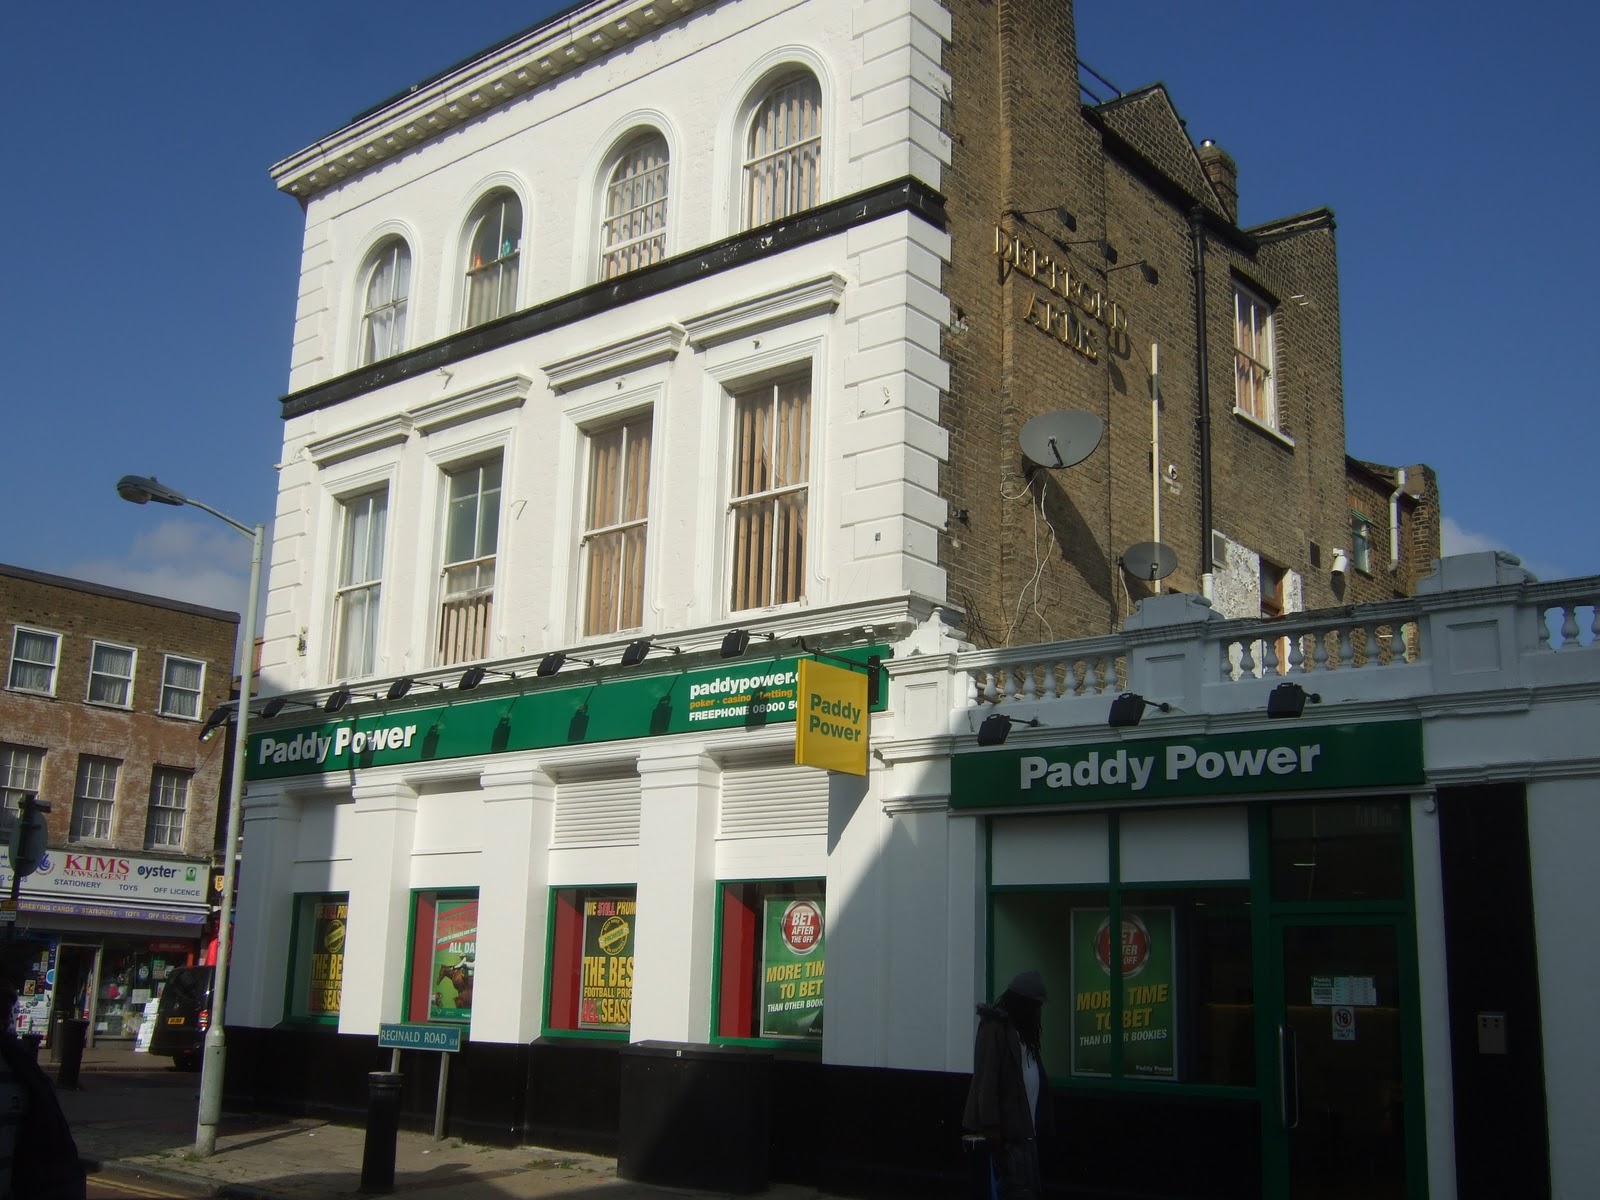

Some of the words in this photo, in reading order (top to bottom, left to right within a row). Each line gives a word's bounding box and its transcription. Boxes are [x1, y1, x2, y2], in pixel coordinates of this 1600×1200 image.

[690, 699, 715, 710] poker
[722, 694, 751, 705] casino
[759, 689, 793, 699] betting
[689, 706, 750, 721] FREEPHONE
[752, 702, 785, 713] 08000
[810, 693, 861, 724] Paddy
[809, 715, 861, 742] Power
[259, 731, 331, 765] Paddy
[334, 724, 416, 756] Power
[1020, 750, 1155, 791] Paddy
[1165, 743, 1320, 780] Power
[64, 854, 130, 874] KIMS
[63, 869, 129, 881] NEWSAGENT
[54, 878, 101, 888] STATIONERY
[119, 884, 138, 892] TOYS
[19, 902, 51, 911] GREETING
[53, 905, 74, 913] CARDS
[81, 907, 117, 916] STATIONERY
[587, 902, 596, 916] WE
[597, 901, 615, 916] STILL
[791, 912, 814, 926] BET
[791, 926, 814, 935] AFTER
[1108, 928, 1137, 945] ET
[802, 935, 814, 943] OFF
[449, 942, 462, 953] ALL
[1108, 945, 1138, 956] TER
[312, 954, 328, 979] THE
[1123, 957, 1138, 965] OFF
[584, 957, 606, 987] THE
[766, 963, 802, 983] MORE
[584, 987, 615, 998] FOOTBALL
[780, 984, 795, 999] TO
[800, 980, 823, 998] BET
[1076, 990, 1111, 1012] MOR
[1127, 984, 1169, 1006] TIME
[767, 1003, 784, 1013] THAN
[784, 1000, 804, 1011] OTHER
[1122, 1008, 1153, 1029] BET
[1337, 1012, 1349, 1024] 18
[381, 1030, 420, 1043] REGINALD
[424, 1032, 447, 1044] ROAD
[1080, 1035, 1100, 1047] THAN
[1103, 1032, 1129, 1045] OTR
[1131, 1029, 1168, 1042] BOOKIES
[1154, 1065, 1172, 1073] Power
